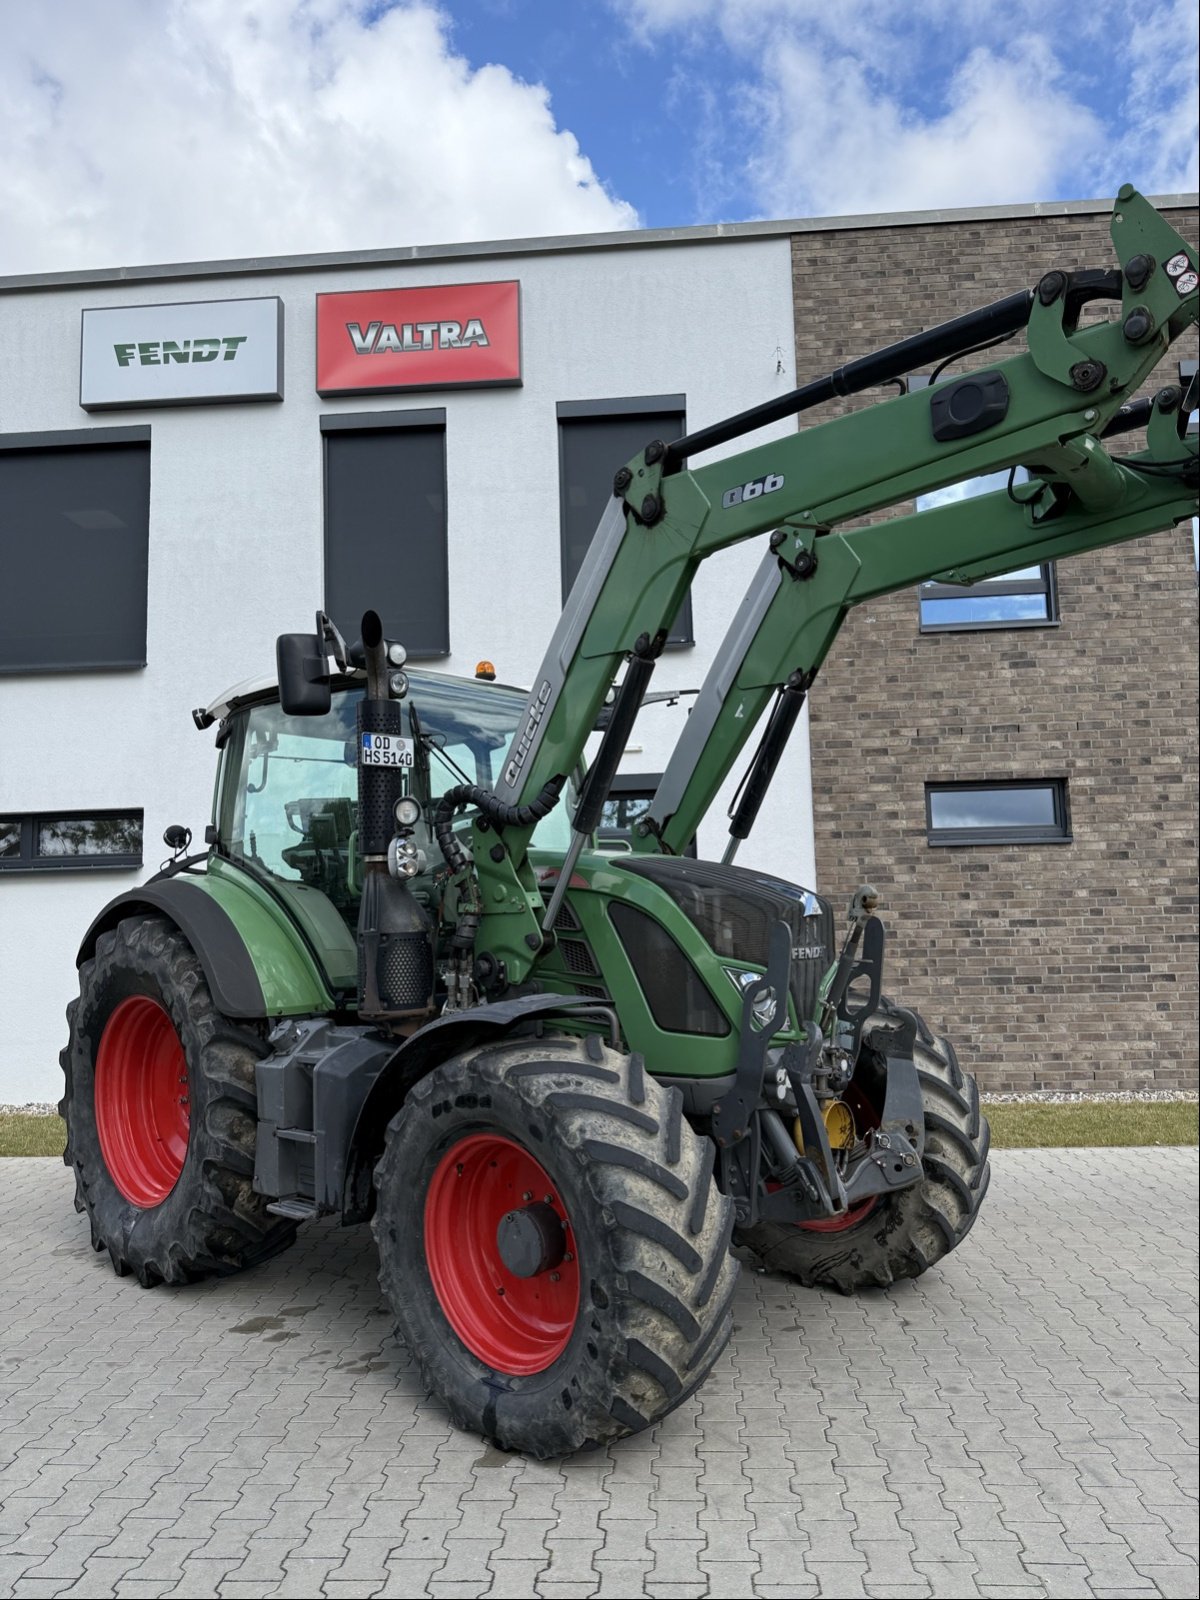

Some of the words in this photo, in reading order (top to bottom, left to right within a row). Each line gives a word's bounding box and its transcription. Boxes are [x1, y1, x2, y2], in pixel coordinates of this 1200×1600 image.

[113, 336, 248, 367] FENDT
[346, 319, 490, 355] VALTRA
[374, 736, 391, 750] OD
